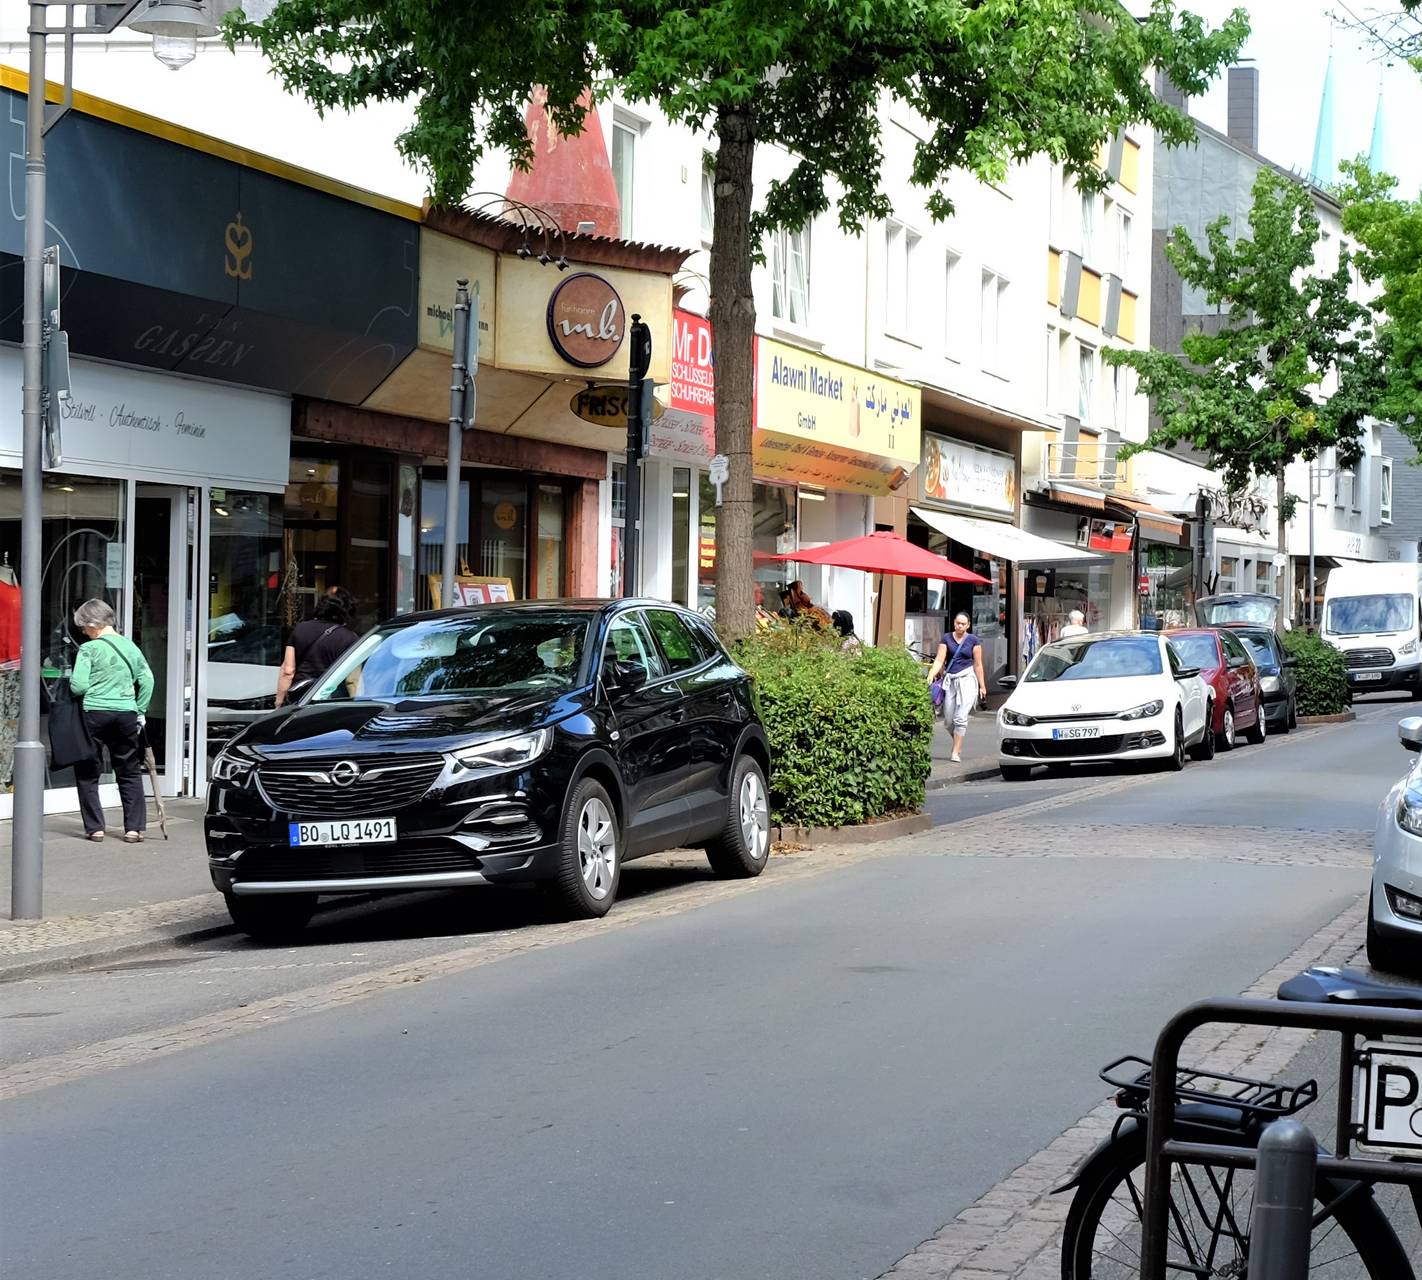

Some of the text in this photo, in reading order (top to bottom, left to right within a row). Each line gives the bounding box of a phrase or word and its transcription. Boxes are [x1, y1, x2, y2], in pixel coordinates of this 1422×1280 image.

[672, 319, 694, 363] Mr.
[771, 355, 843, 401] Alawni Market
[797, 411, 816, 430] GmbH
[1082, 727, 1099, 737] 797
[300, 821, 393, 842] BO LQ 1491
[1375, 1065, 1419, 1130] P
